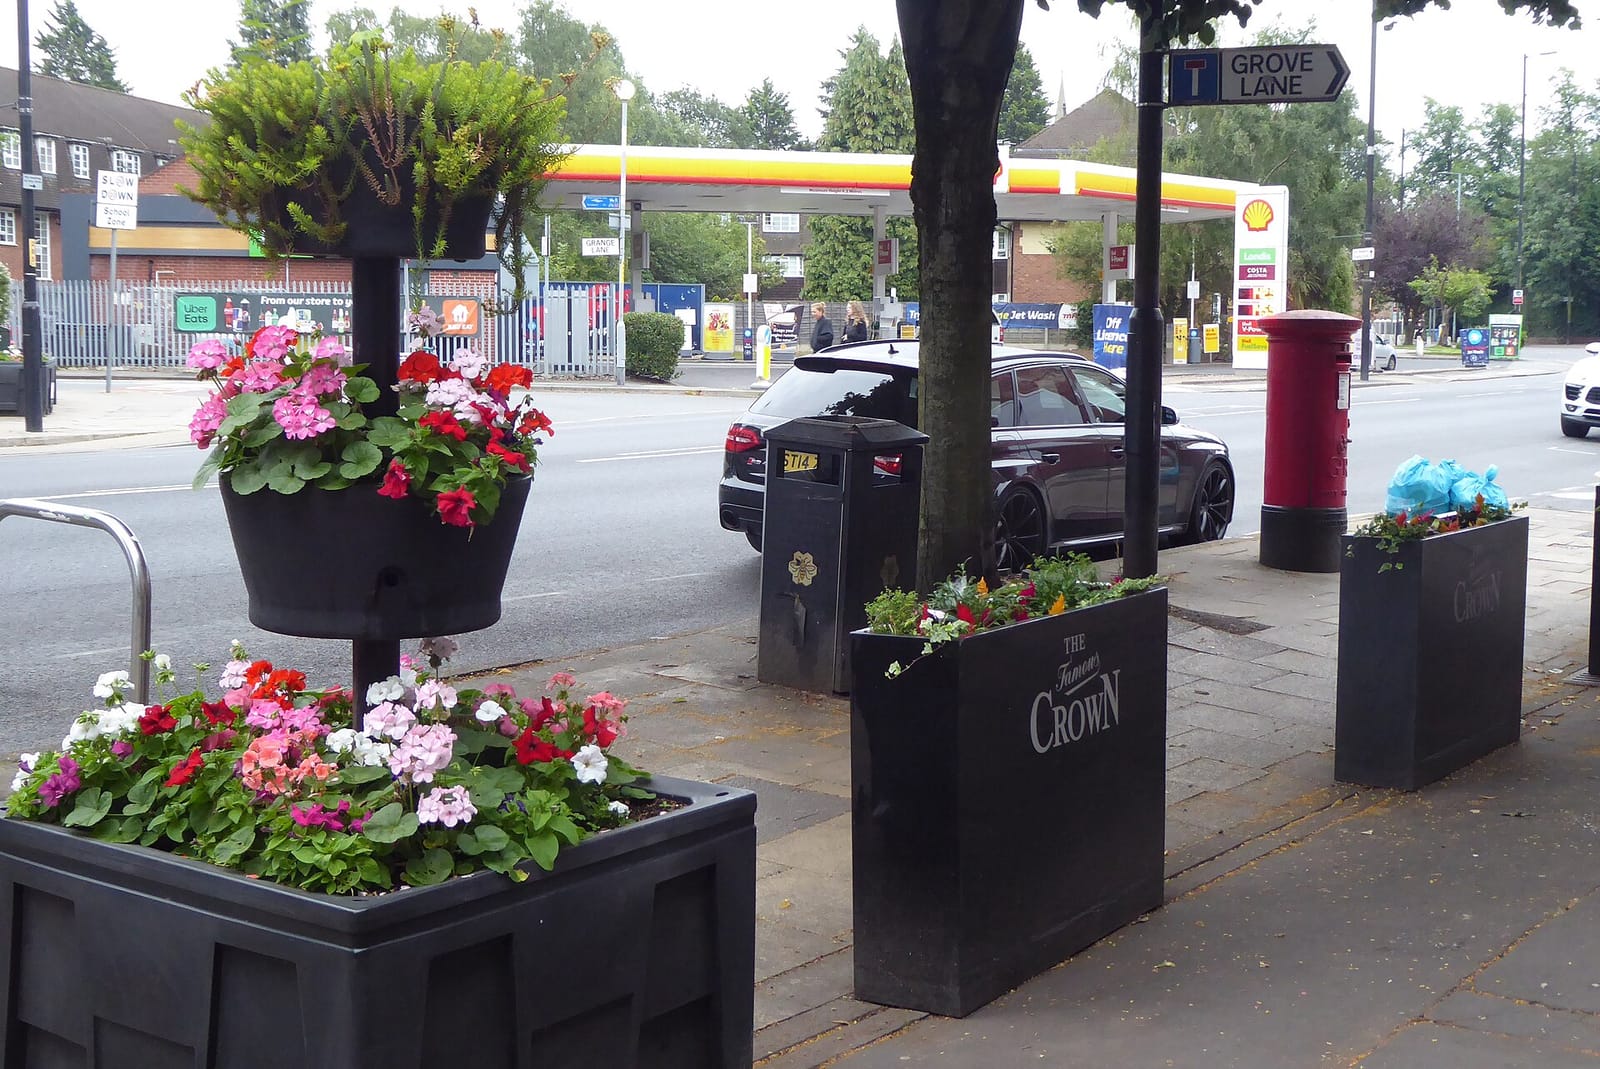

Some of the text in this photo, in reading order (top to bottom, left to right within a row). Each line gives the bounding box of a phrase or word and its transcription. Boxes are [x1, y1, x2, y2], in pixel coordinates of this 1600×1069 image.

[1231, 51, 1313, 74] GROVE
[1240, 75, 1302, 97] LANE
[102, 175, 134, 187] SLOW
[101, 189, 134, 200] DOWN
[103, 206, 130, 217] School
[107, 216, 126, 226] Zone
[585, 239, 616, 247] GRANGE
[591, 246, 609, 254] LANE
[1243, 251, 1271, 260] Londis
[260, 295, 285, 305] From
[286, 297, 304, 306] our
[304, 296, 331, 306] store
[332, 297, 343, 306] to
[183, 304, 208, 313] Uber
[184, 314, 209, 323] Eats
[1010, 310, 1026, 320] Jet
[1026, 310, 1056, 320] Wash
[1105, 317, 1122, 329] Off
[1103, 345, 1125, 354] Here
[1063, 632, 1086, 655] THE
[1055, 651, 1101, 692] Famous
[1030, 669, 1121, 754] CROWN
